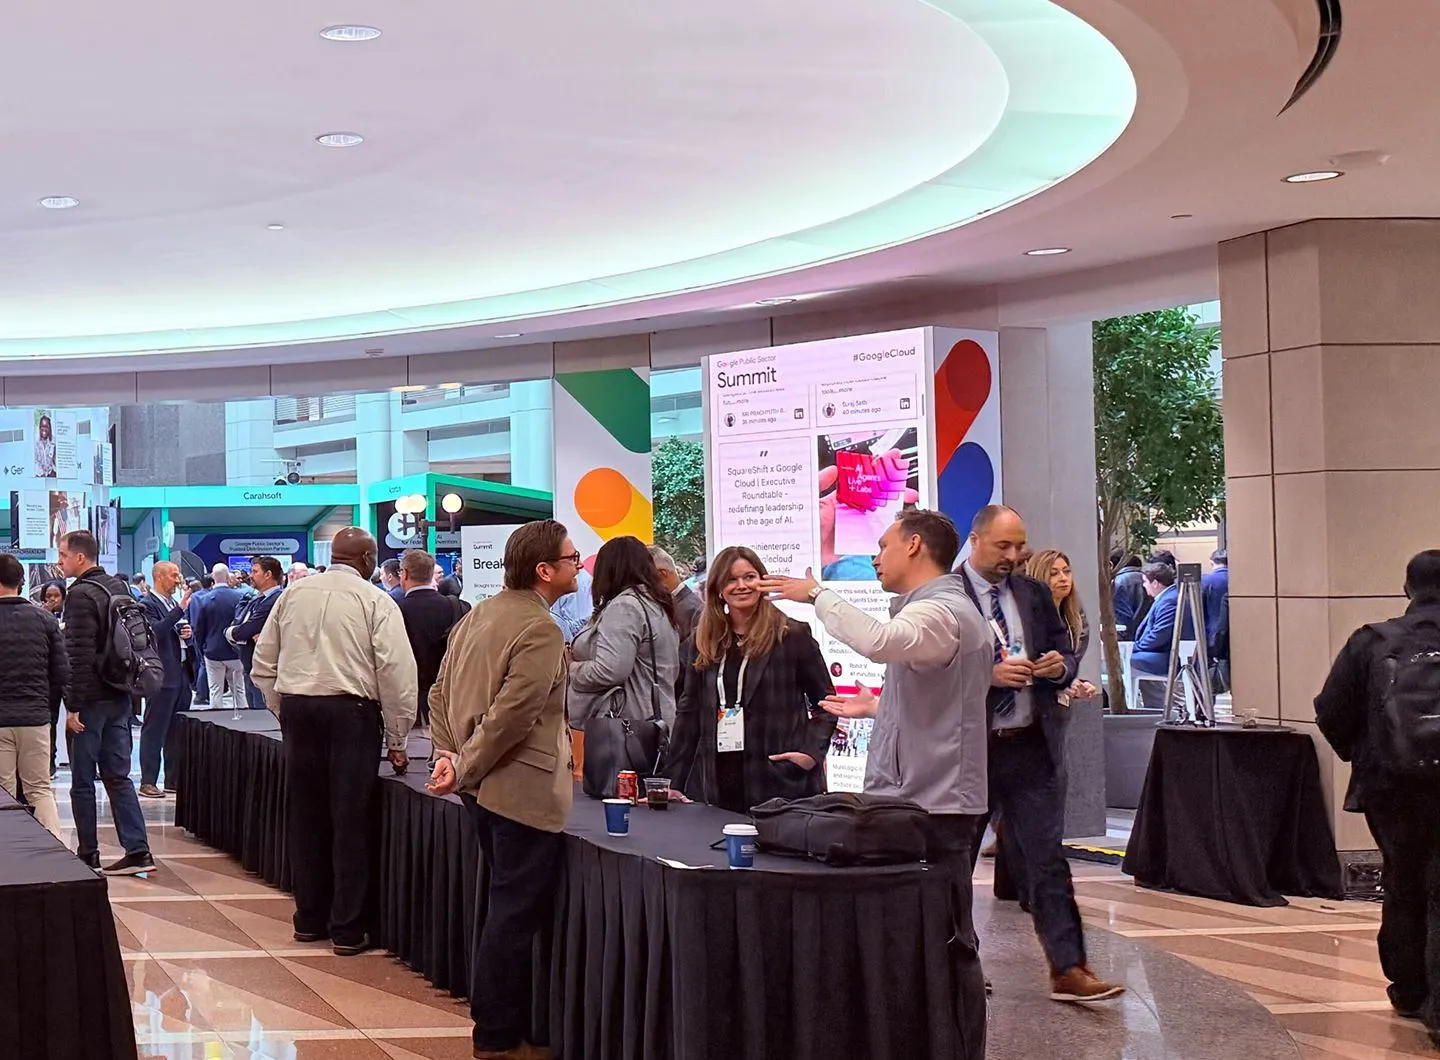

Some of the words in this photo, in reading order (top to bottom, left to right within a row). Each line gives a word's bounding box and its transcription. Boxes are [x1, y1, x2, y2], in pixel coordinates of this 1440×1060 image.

[853, 347, 916, 362] #GoogleCloud
[717, 366, 777, 388] Summit
[775, 463, 803, 474] Google
[734, 478, 756, 488] Cloud
[761, 478, 796, 487] Executive
[243, 491, 282, 500] Carahsoft
[742, 490, 783, 500] Roundtable
[728, 504, 764, 514] redefining
[765, 502, 804, 512] leadership
[738, 518, 745, 526] in
[746, 517, 759, 526] the
[759, 518, 774, 526] age
[775, 515, 783, 524] of
[473, 558, 504, 570] Break
